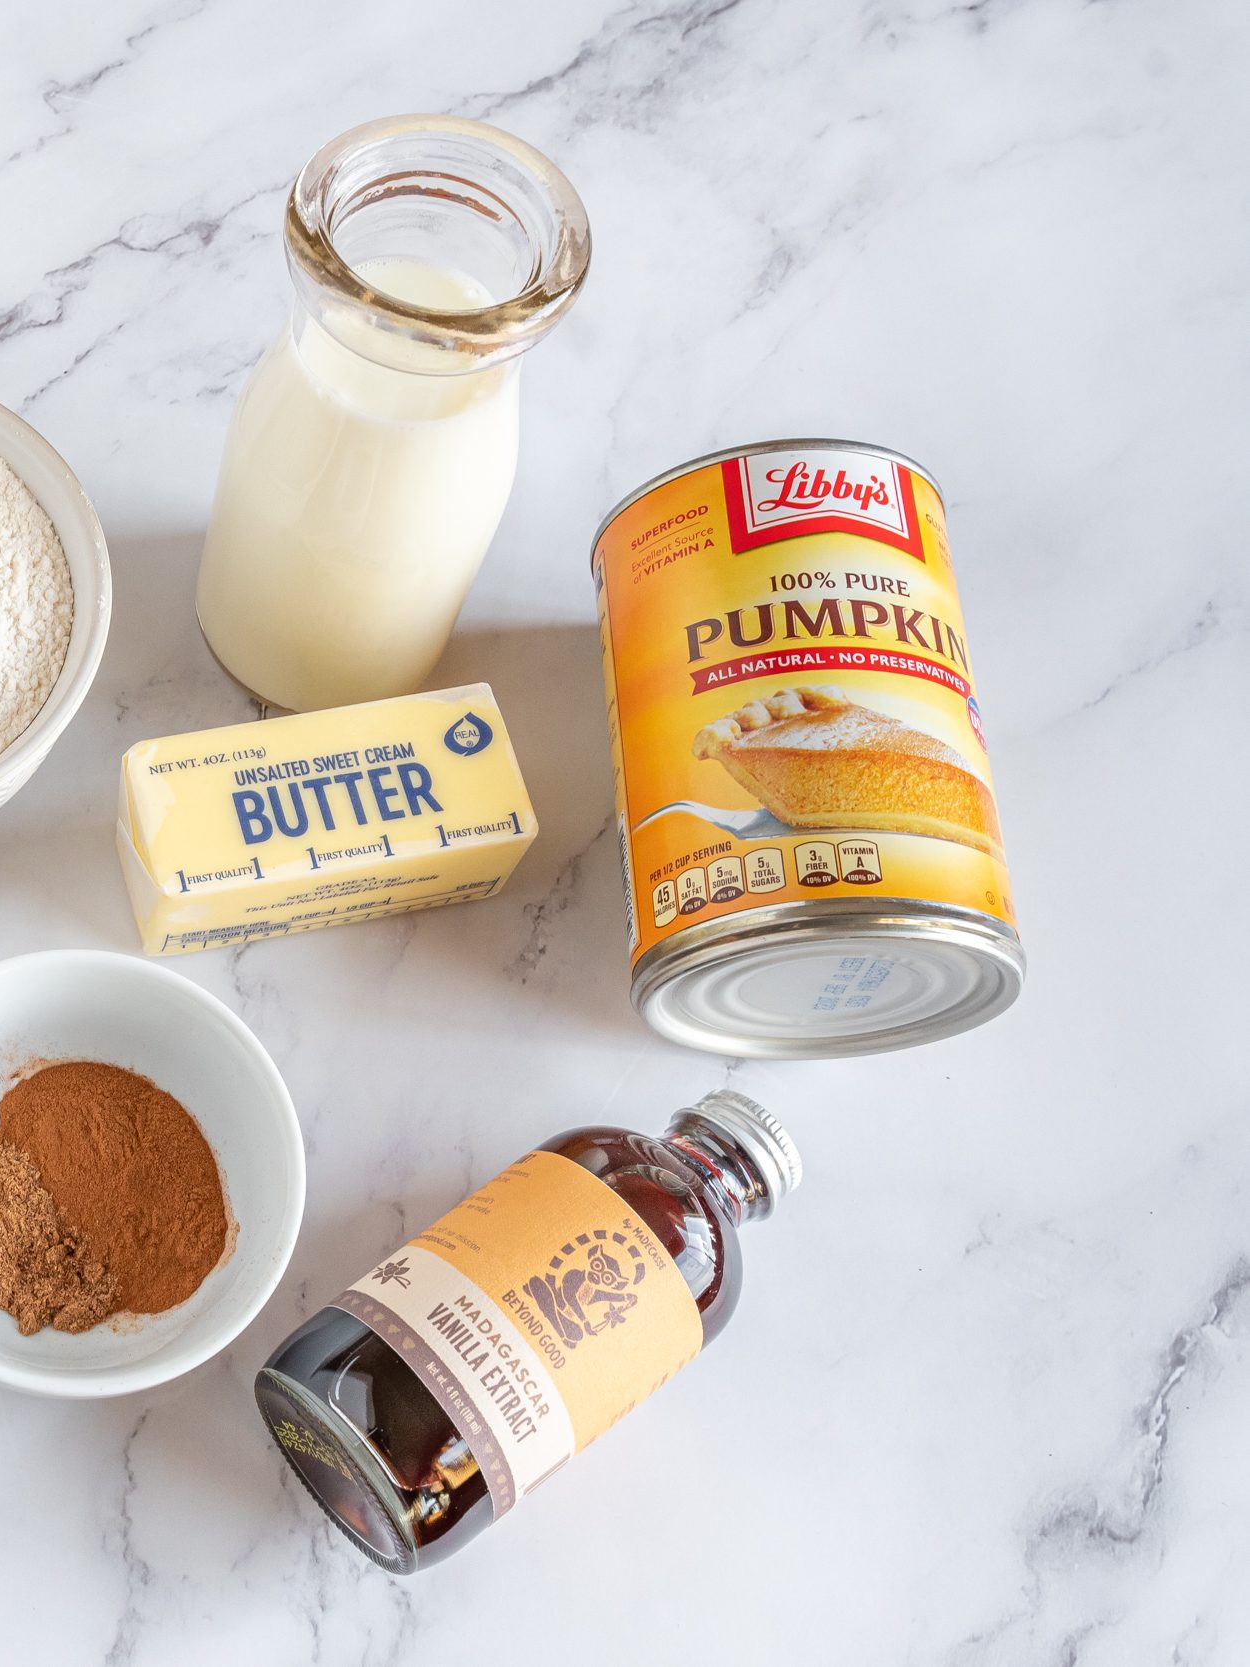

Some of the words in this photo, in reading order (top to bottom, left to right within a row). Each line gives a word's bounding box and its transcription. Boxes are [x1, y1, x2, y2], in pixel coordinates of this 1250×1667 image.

[757, 461, 890, 512] Libby's
[631, 505, 709, 551] SUPERFOOD
[631, 543, 672, 573] Excellent
[674, 527, 714, 547] Source
[644, 543, 699, 576] VITAMIN
[704, 538, 715, 550] A
[769, 571, 837, 593] 100%
[845, 572, 911, 598] PURE
[684, 598, 969, 675] PUMPKIN
[707, 669, 738, 684] ALL
[742, 651, 825, 673] NATURAL
[839, 652, 865, 664] NO
[870, 655, 965, 692] PRESERVATIVES
[455, 729, 480, 740] REAL
[149, 762, 173, 775] NET
[176, 757, 201, 770] WT.
[232, 747, 267, 762] (113g)
[234, 760, 310, 787] UNSALTED
[313, 750, 360, 774] SWEET
[365, 742, 415, 764] CREAM
[232, 762, 444, 845] BUTTER
[447, 828, 471, 839] FIRST
[474, 821, 512, 835] QUALITY
[317, 850, 343, 862] FIRST
[344, 843, 383, 857] QUALITY
[842, 847, 874, 855] VITAMIN
[649, 869, 662, 884] PER
[663, 863, 673, 875] 1/2
[675, 854, 690, 869] CUP
[692, 841, 732, 862] SERVING
[806, 862, 829, 871] FIBER
[857, 856, 864, 868] A
[187, 873, 213, 885] FIRST
[214, 866, 253, 881] QUALITY
[712, 875, 739, 888] SODIUM
[751, 876, 781, 888] SUGARS
[753, 868, 776, 879] TOTAL
[806, 876, 822, 884] 10%
[657, 885, 670, 906] 45
[681, 891, 691, 900] SAT
[692, 886, 702, 896] FAT
[655, 901, 676, 917] CALORIES
[180, 930, 240, 943] TABLESPOON
[243, 923, 290, 935] MEASURE
[181, 930, 206, 938] START
[208, 924, 247, 934] MEASURE
[249, 920, 270, 928] HERE
[502, 1289, 544, 1336] BEYOND
[539, 1334, 566, 1369] GOOD
[454, 1295, 550, 1419] MADAGASCAR
[426, 1361, 440, 1376] Net
[427, 1302, 490, 1372] VANILLA
[480, 1366, 537, 1443] EXTRACT
